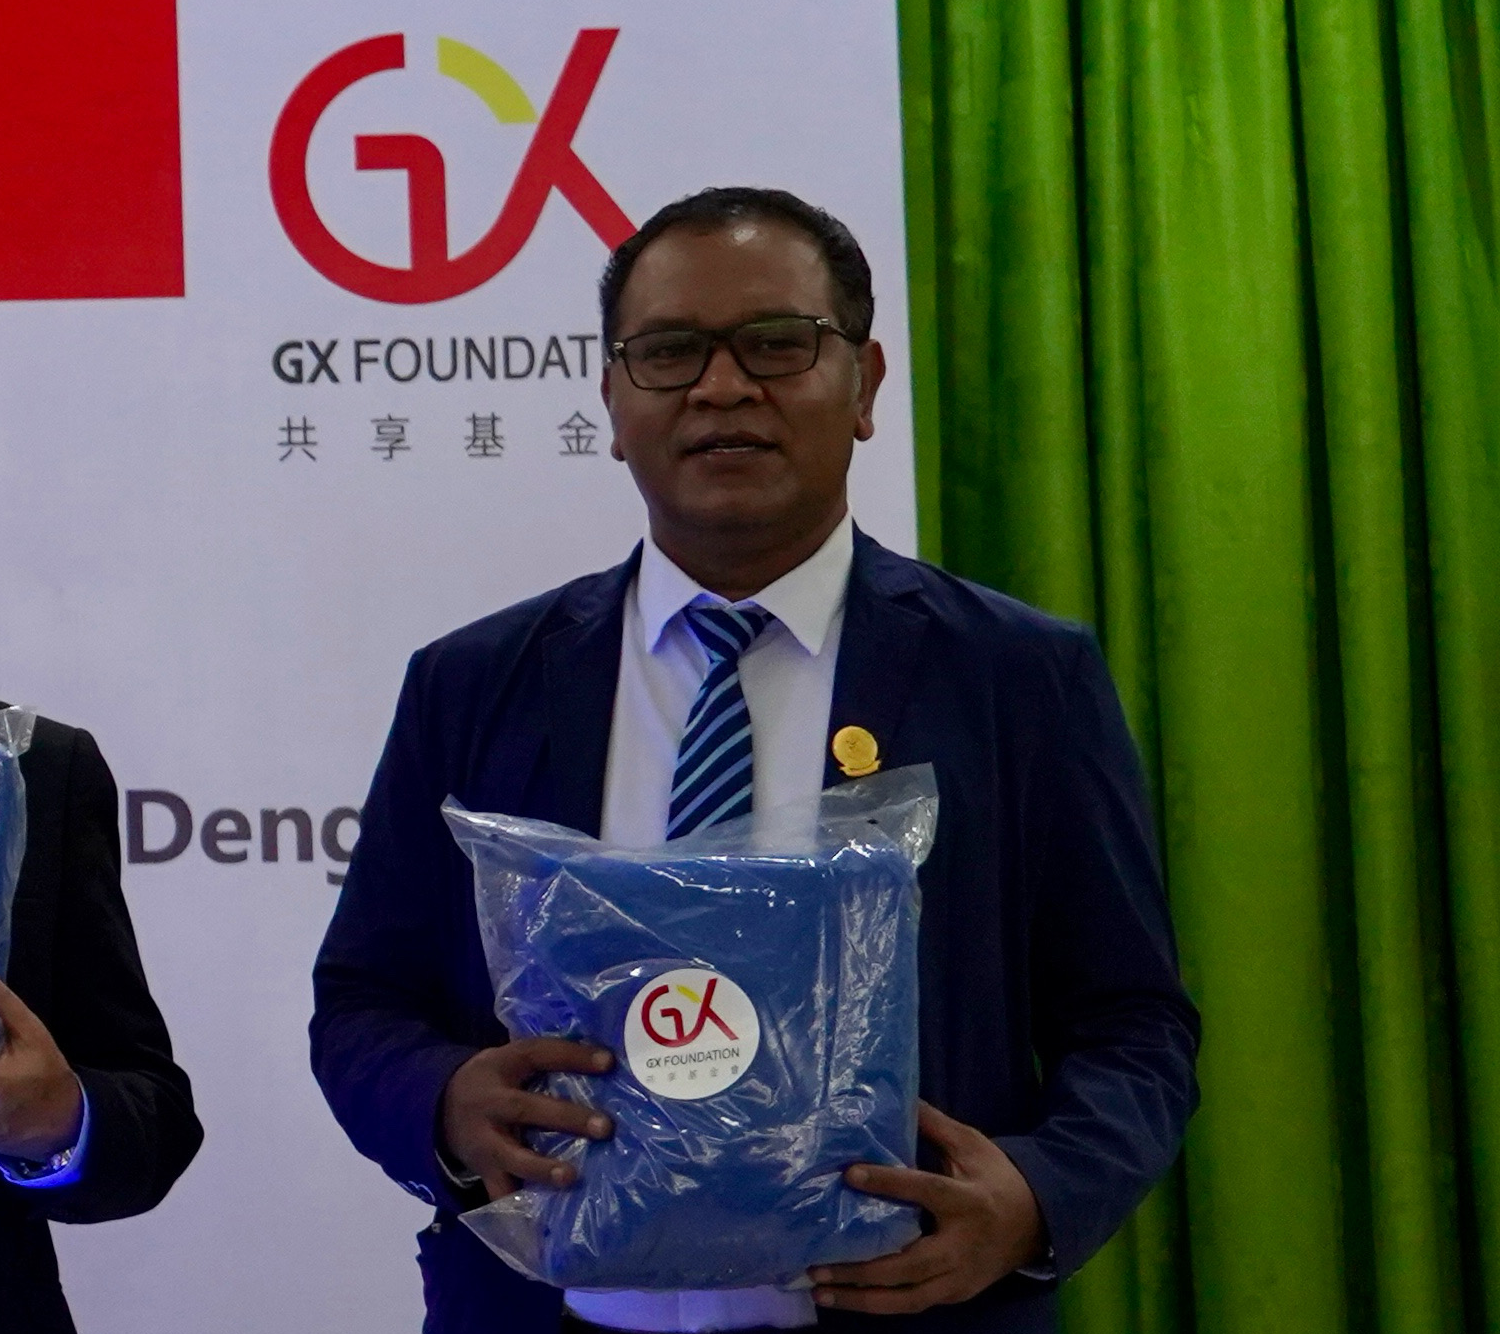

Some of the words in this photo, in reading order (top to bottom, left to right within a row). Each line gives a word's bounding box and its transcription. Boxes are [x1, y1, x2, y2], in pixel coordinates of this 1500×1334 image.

[268, 27, 640, 305] GX
[271, 339, 340, 384] GX
[354, 334, 599, 383] FOUNDAT
[278, 410, 599, 463] 共享基金
[124, 788, 362, 887] Deng
[641, 978, 739, 1047] GX
[664, 1047, 740, 1066] FOUNDATION
